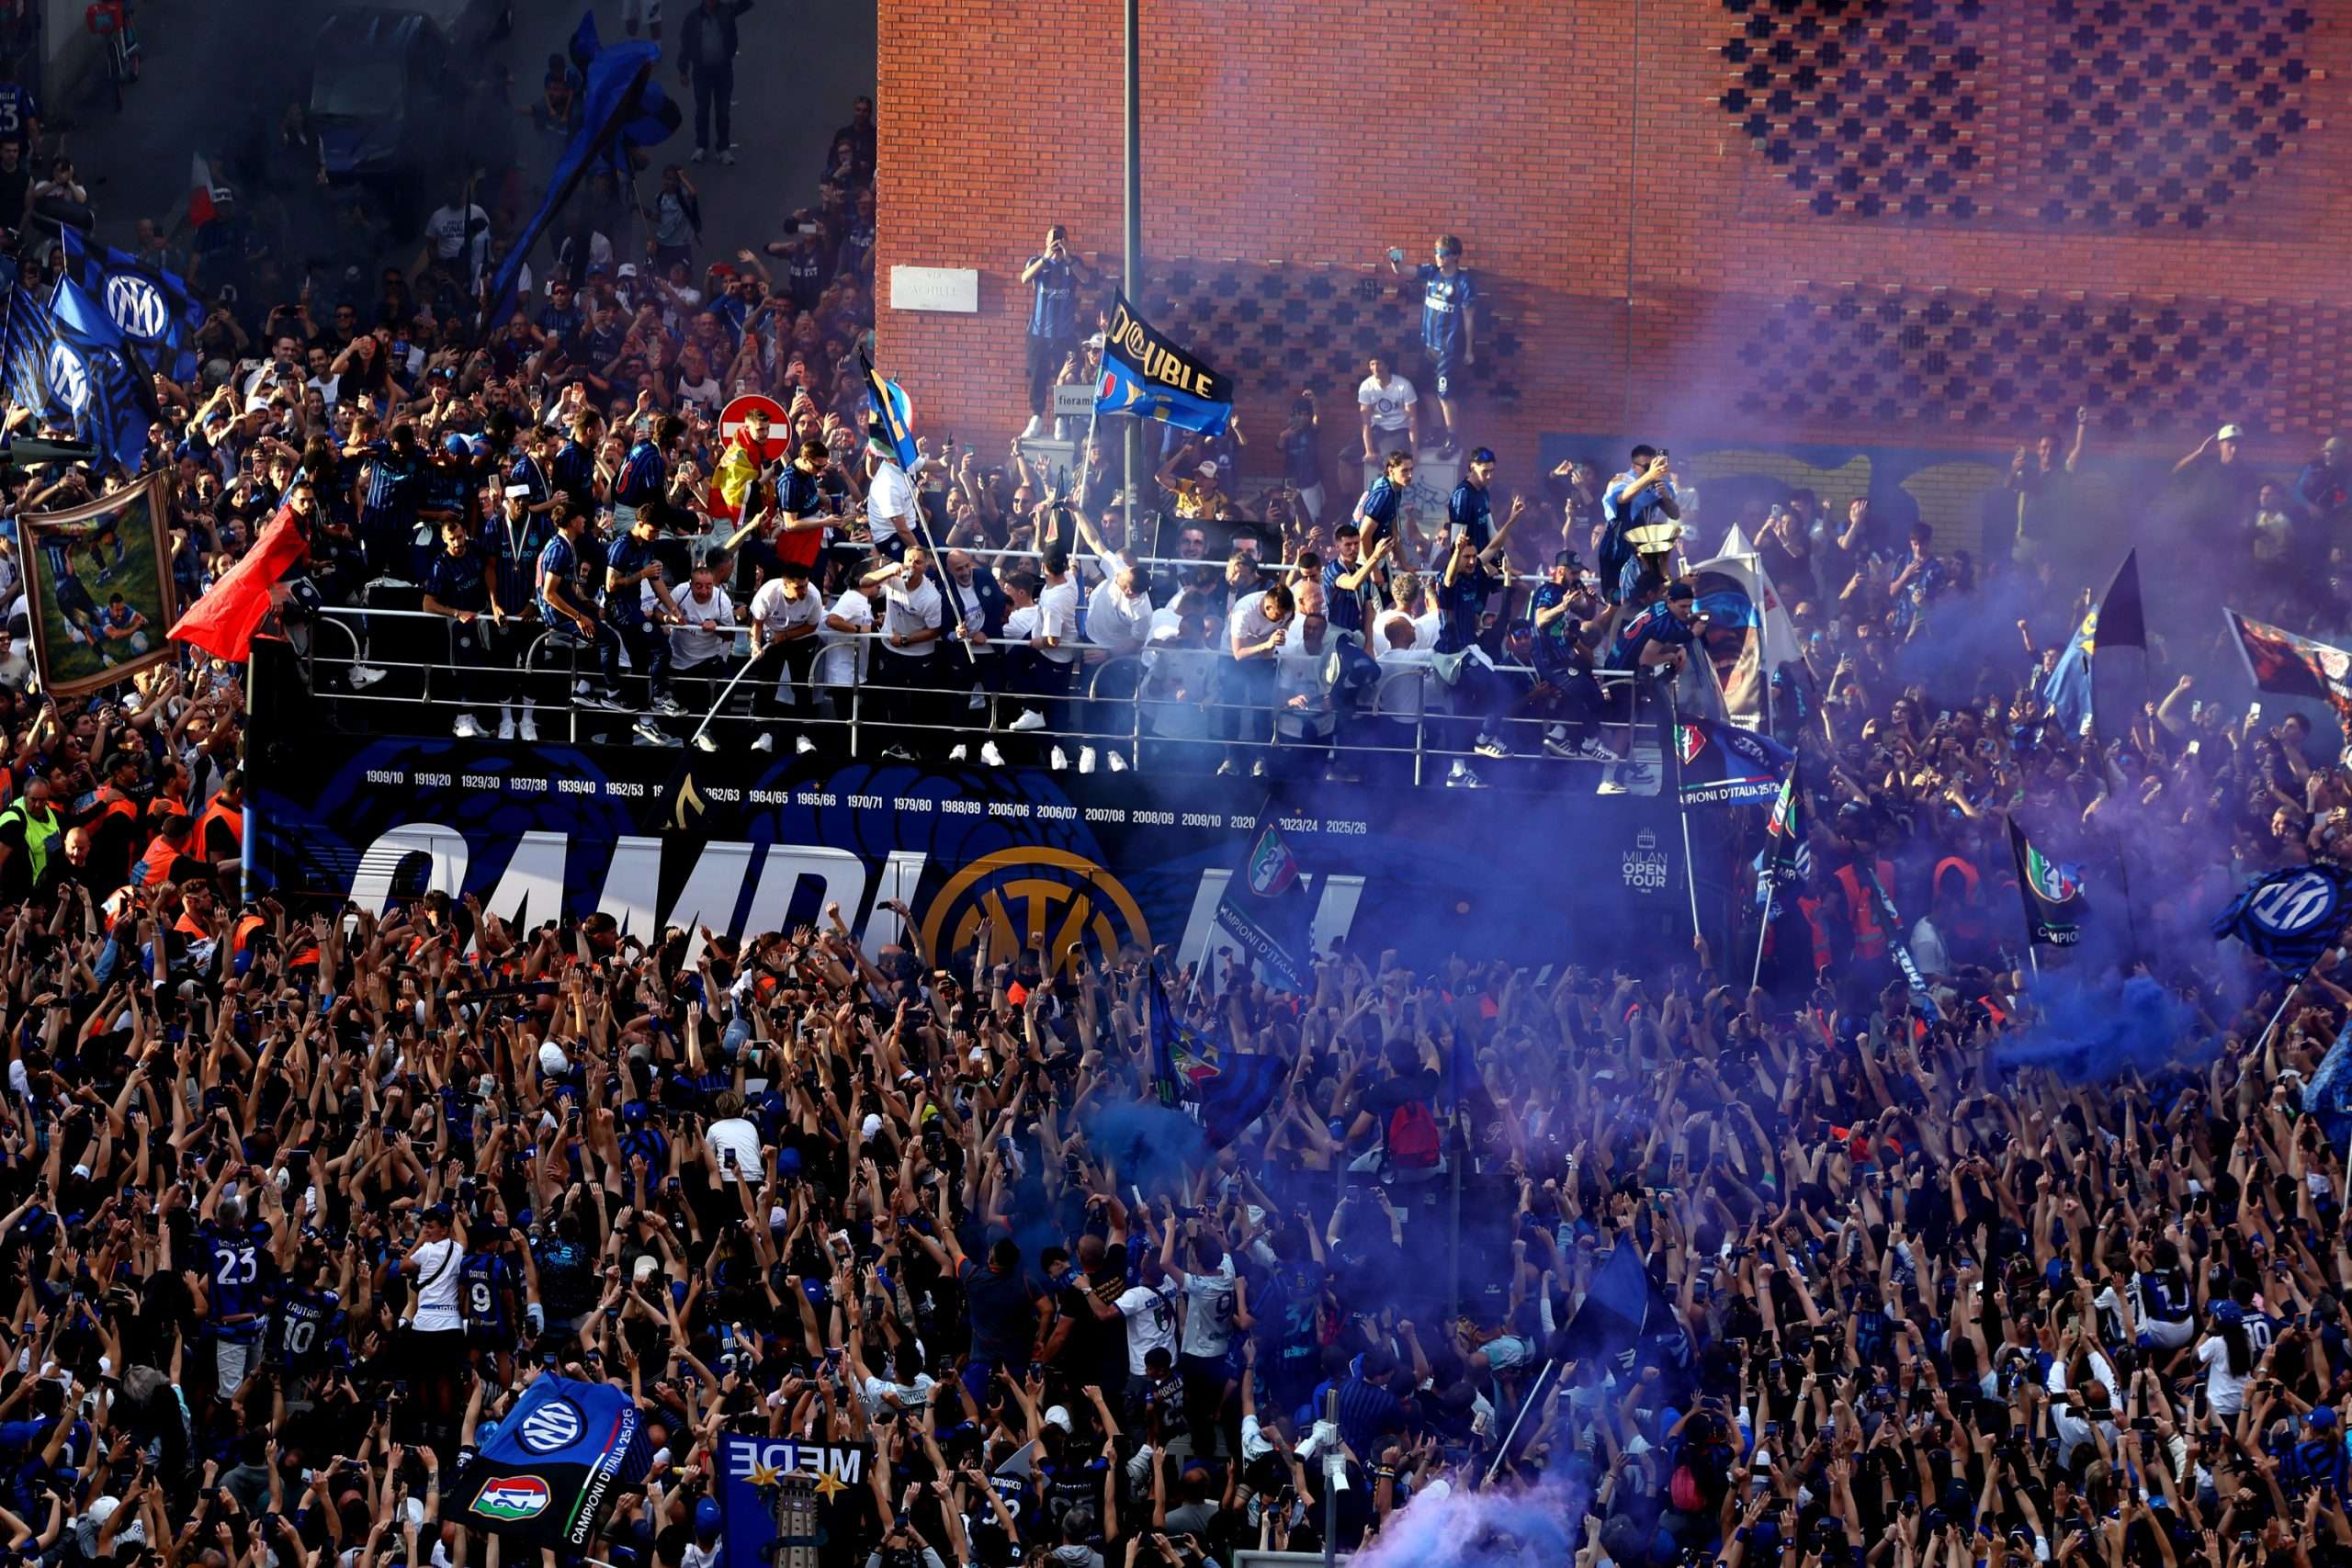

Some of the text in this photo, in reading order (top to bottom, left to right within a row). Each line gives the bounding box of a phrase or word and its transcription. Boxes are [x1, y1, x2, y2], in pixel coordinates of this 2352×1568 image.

[367, 770, 404, 785] 1909/10
[414, 773, 451, 787] 1919/20
[461, 775, 501, 790] 1929/30
[510, 777, 548, 792] 1937/38
[558, 780, 596, 795] 1939/40
[605, 782, 643, 797] 1952/53
[749, 789, 788, 805] 1964/65
[797, 792, 836, 807] 1965/66
[847, 795, 883, 809] 1970/71
[893, 797, 932, 812] 1979/80
[941, 800, 980, 815] 1988/89
[989, 803, 1030, 818] 2005/06
[1037, 805, 1078, 820] 2006/07
[1085, 807, 1125, 823] 2007/08
[1132, 810, 1174, 826] 2008/09
[1182, 813, 1221, 829] 2009/10
[1230, 816, 1255, 829] 2020
[1326, 820, 1367, 835] 2025/26
[1679, 790, 1718, 805] PIONI
[1623, 851, 1668, 864] MILAN
[1623, 863, 1667, 875] OPEN
[1623, 874, 1666, 887] TOUR
[214, 1246, 257, 1285] 23
[471, 1282, 491, 1313] 9
[1215, 1290, 1234, 1325] 9
[283, 1314, 316, 1354] 10
[571, 1483, 606, 1544] CAMPIONI
[598, 1446, 628, 1483] D'ITALIA
[990, 1477, 1022, 1490] DIMARCO
